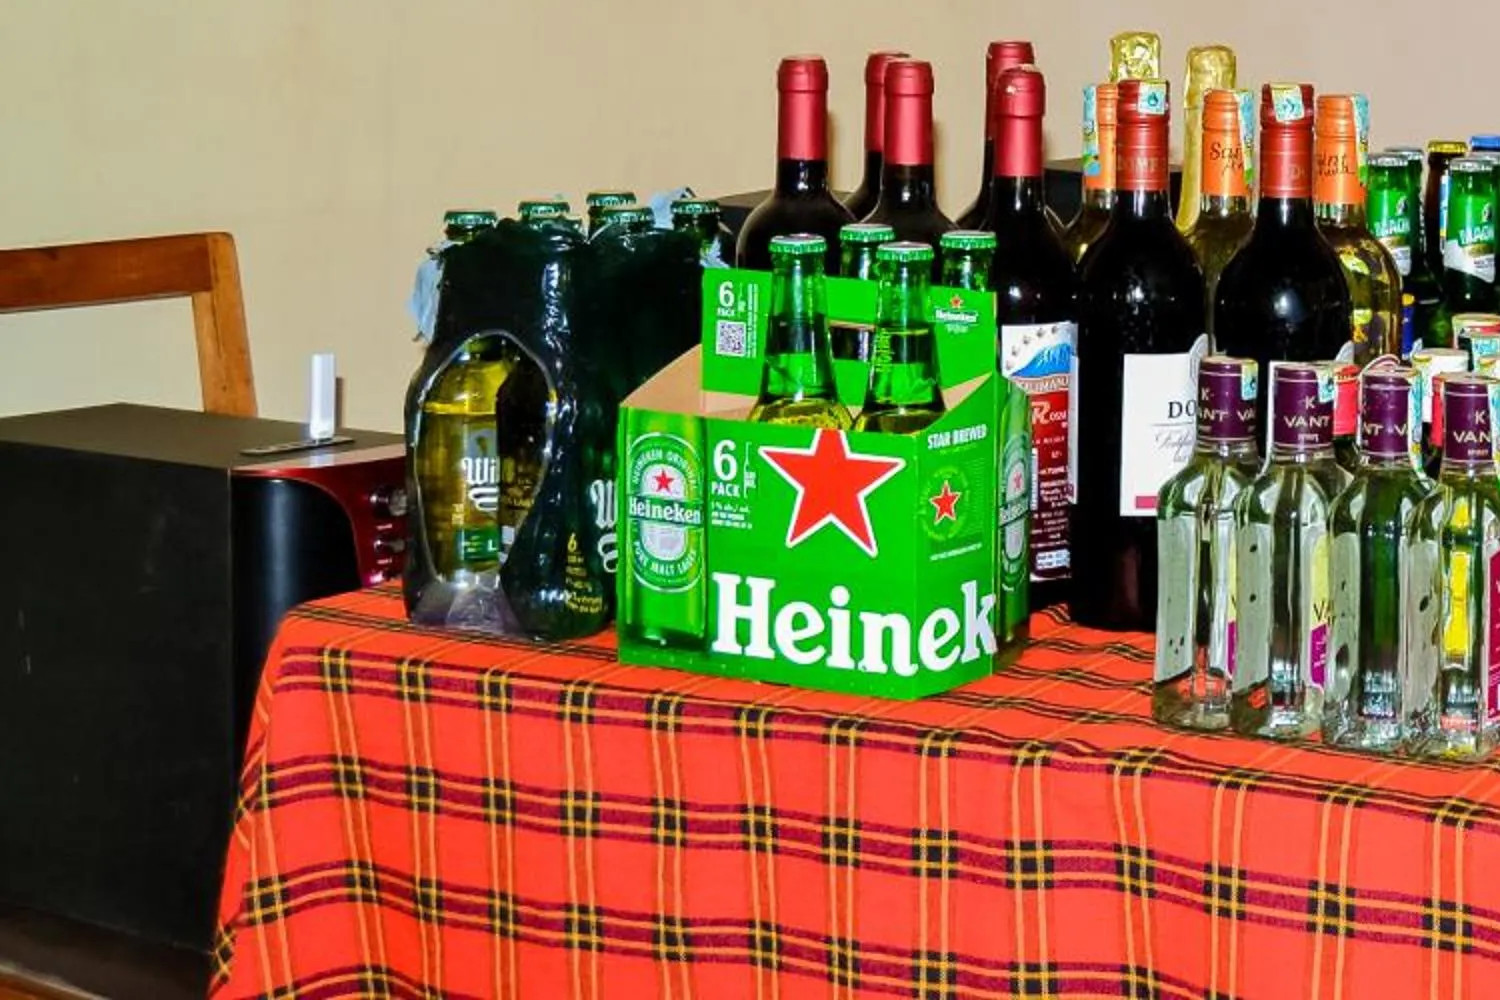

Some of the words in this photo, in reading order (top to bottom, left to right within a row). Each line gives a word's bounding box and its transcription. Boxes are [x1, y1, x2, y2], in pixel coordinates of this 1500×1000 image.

[719, 281, 735, 307] 6
[1305, 396, 1315, 409] K
[1284, 415, 1331, 428] VANT
[1475, 410, 1486, 424] K
[928, 431, 951, 450] STAR
[1453, 430, 1491, 443] VAN
[713, 439, 738, 481] 6
[711, 481, 741, 498] PACK
[629, 496, 703, 525] Heineken
[711, 572, 998, 677] Heinek
